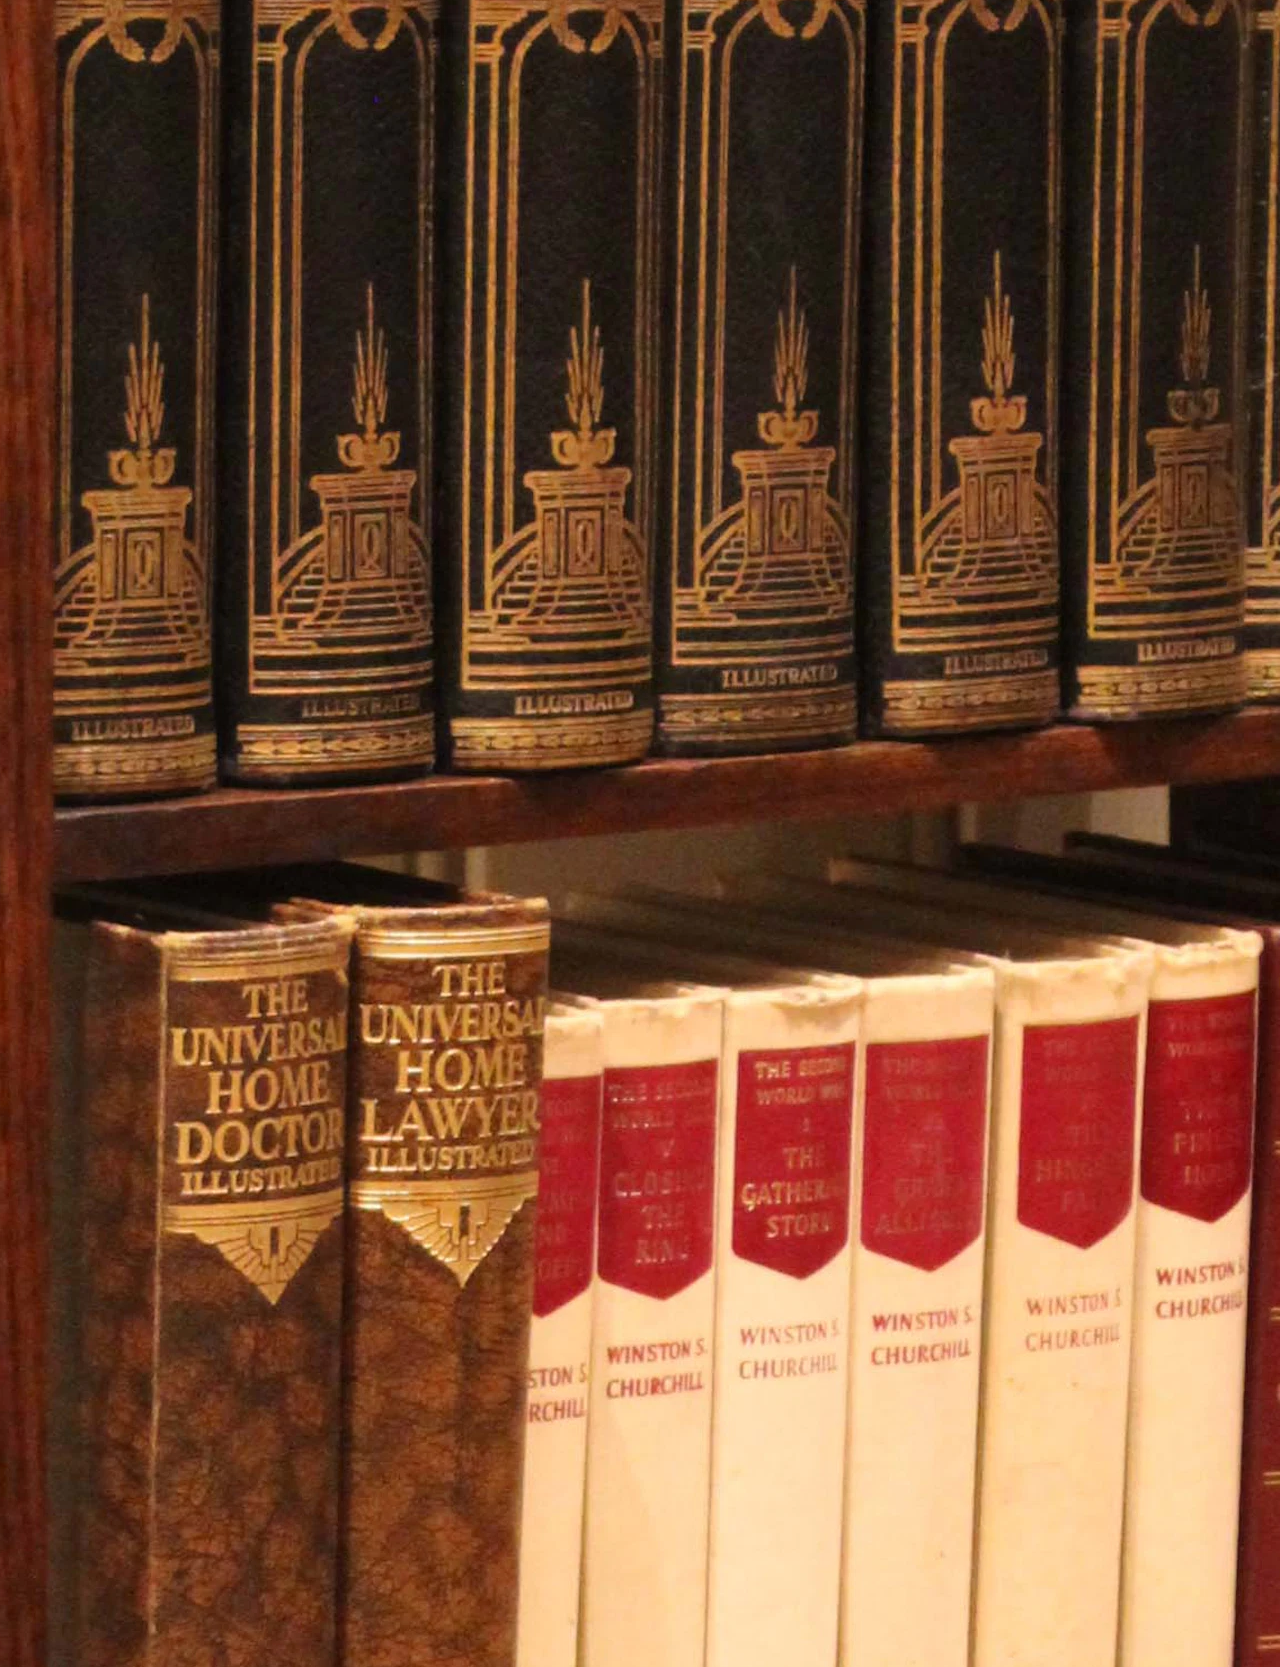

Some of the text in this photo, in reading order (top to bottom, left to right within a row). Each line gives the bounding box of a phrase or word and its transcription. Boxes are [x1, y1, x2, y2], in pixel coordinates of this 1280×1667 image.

[721, 664, 838, 689] ILLUSTRATED
[513, 690, 634, 716] ILLUSTRATED
[431, 962, 507, 998] THE
[242, 979, 308, 1020] THE
[360, 996, 546, 1045] UNIVERSAL
[171, 1012, 347, 1067] UNIVERSAL
[395, 1044, 528, 1093] HOME
[753, 1061, 793, 1081] THE
[205, 1060, 332, 1115] HOME
[360, 1091, 542, 1143] LAWYER
[175, 1107, 345, 1167] DOCTOR
[366, 1141, 537, 1173] ILLUSTRATED
[783, 1145, 825, 1169] THE
[181, 1158, 341, 1196] ILLUSTRATED
[741, 1175, 848, 1212] GATHER
[1156, 1261, 1235, 1287] WINSTON
[1027, 1290, 1109, 1318] WINSTON
[1155, 1288, 1244, 1320] CHURCHILL
[740, 1323, 826, 1347] WINSTON
[872, 1309, 958, 1332] WINSTON
[871, 1338, 971, 1367] CHURCHILL
[1025, 1323, 1121, 1353] CHURCHILL
[607, 1342, 691, 1365] WINSTON
[739, 1354, 839, 1381] CHURCHILL
[528, 1366, 574, 1390] STON
[606, 1372, 704, 1400] CHURCHILL
[528, 1396, 587, 1424] RCHILL
